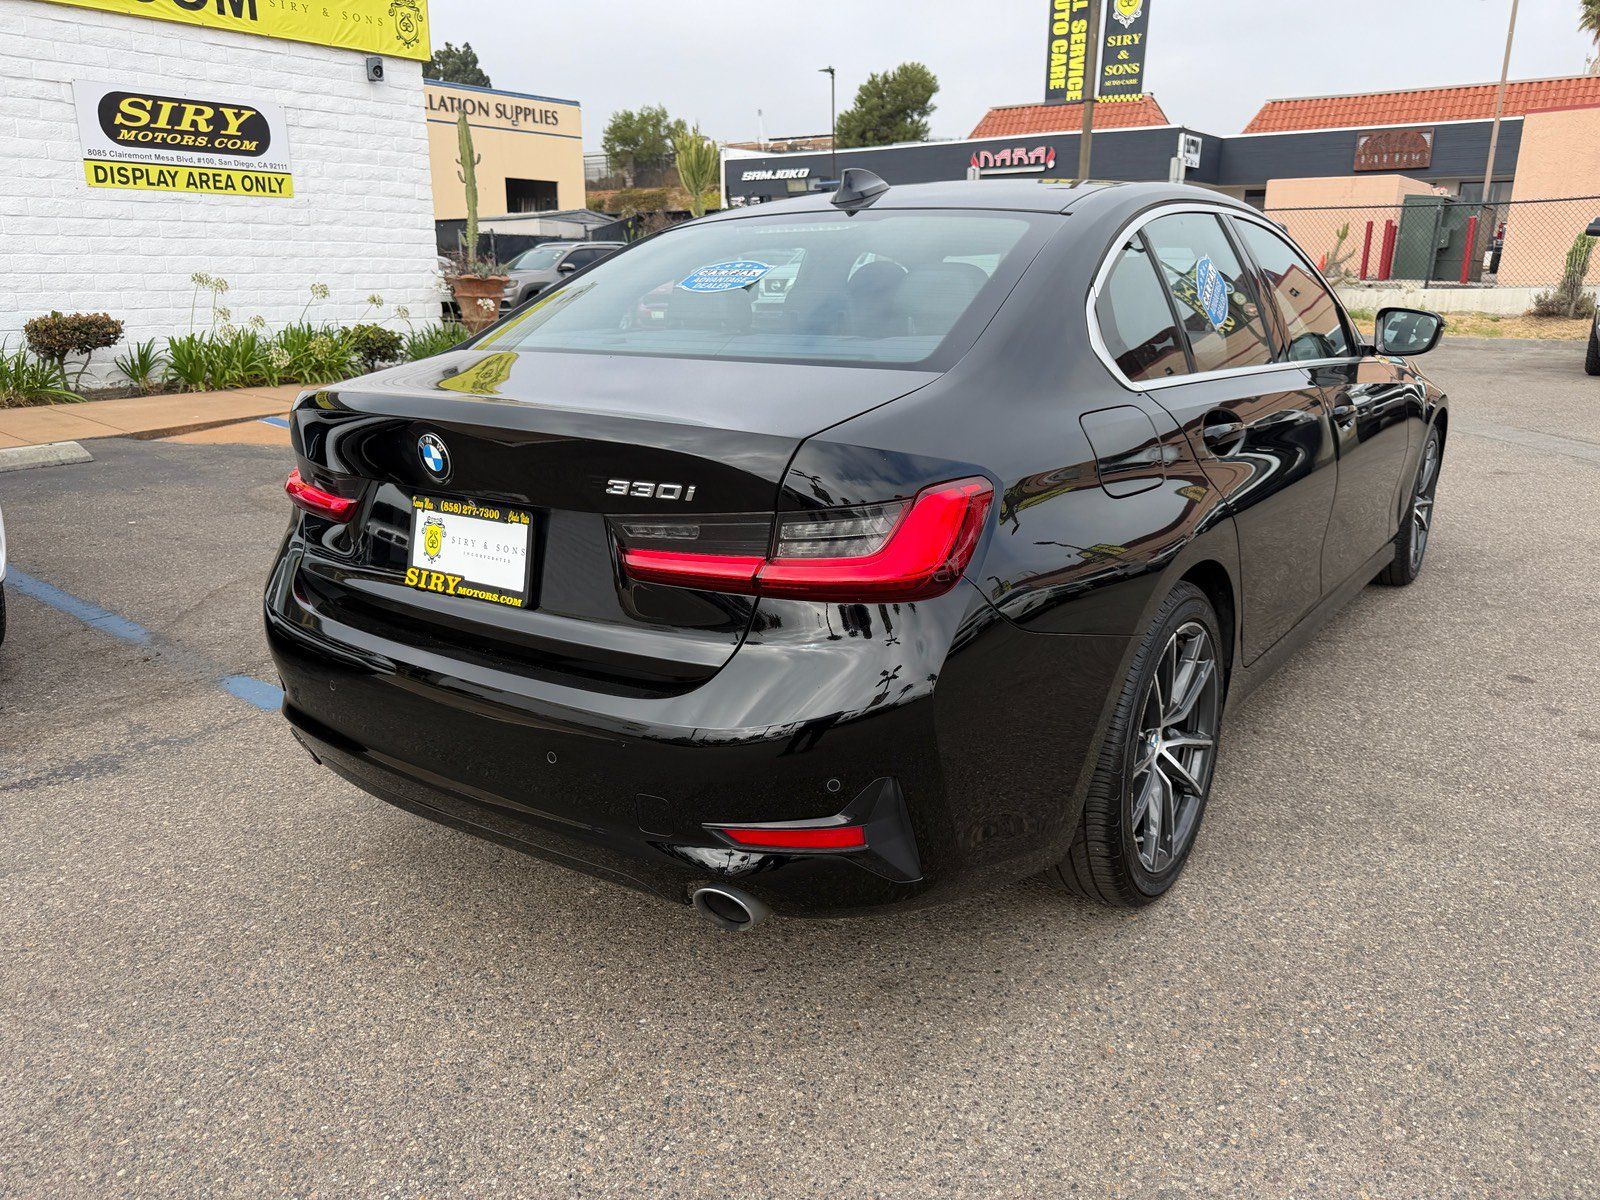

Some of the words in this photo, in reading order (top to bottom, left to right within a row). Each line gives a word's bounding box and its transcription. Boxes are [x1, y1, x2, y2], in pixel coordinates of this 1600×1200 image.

[269, 0, 308, 14] SIRY
[322, 7, 329, 17] &
[342, 11, 384, 27] SONS
[1053, 0, 1070, 36] UTO
[1107, 33, 1142, 47] SIRY
[1049, 39, 1068, 90] CARE
[1066, 19, 1087, 101] SERVICE
[1117, 50, 1129, 60] &
[1104, 63, 1140, 76] SONS
[113, 97, 256, 136] SIRY
[425, 94, 490, 118] LATION
[495, 102, 559, 126] SUPPLIES
[117, 129, 259, 151] MOTORS.COM
[87, 148, 107, 157] 8085
[108, 149, 153, 161] Clairemont
[154, 153, 175, 162] Mesa
[218, 158, 233, 166] San
[234, 159, 257, 169] Diego,
[269, 162, 288, 170] 92111
[979, 146, 1047, 168] NARA
[93, 164, 180, 188] DISPLAY
[185, 171, 237, 191] AREA
[241, 174, 286, 194] ONLY
[741, 167, 810, 181] SAMJOKO
[605, 479, 697, 502] 330i
[440, 500, 461, 515] (858)
[462, 504, 500, 520] 277-7300
[451, 536, 477, 547] SIRY
[495, 544, 526, 557] SONS
[404, 567, 461, 595] SIRY
[457, 587, 522, 606] MOTORS.COM
